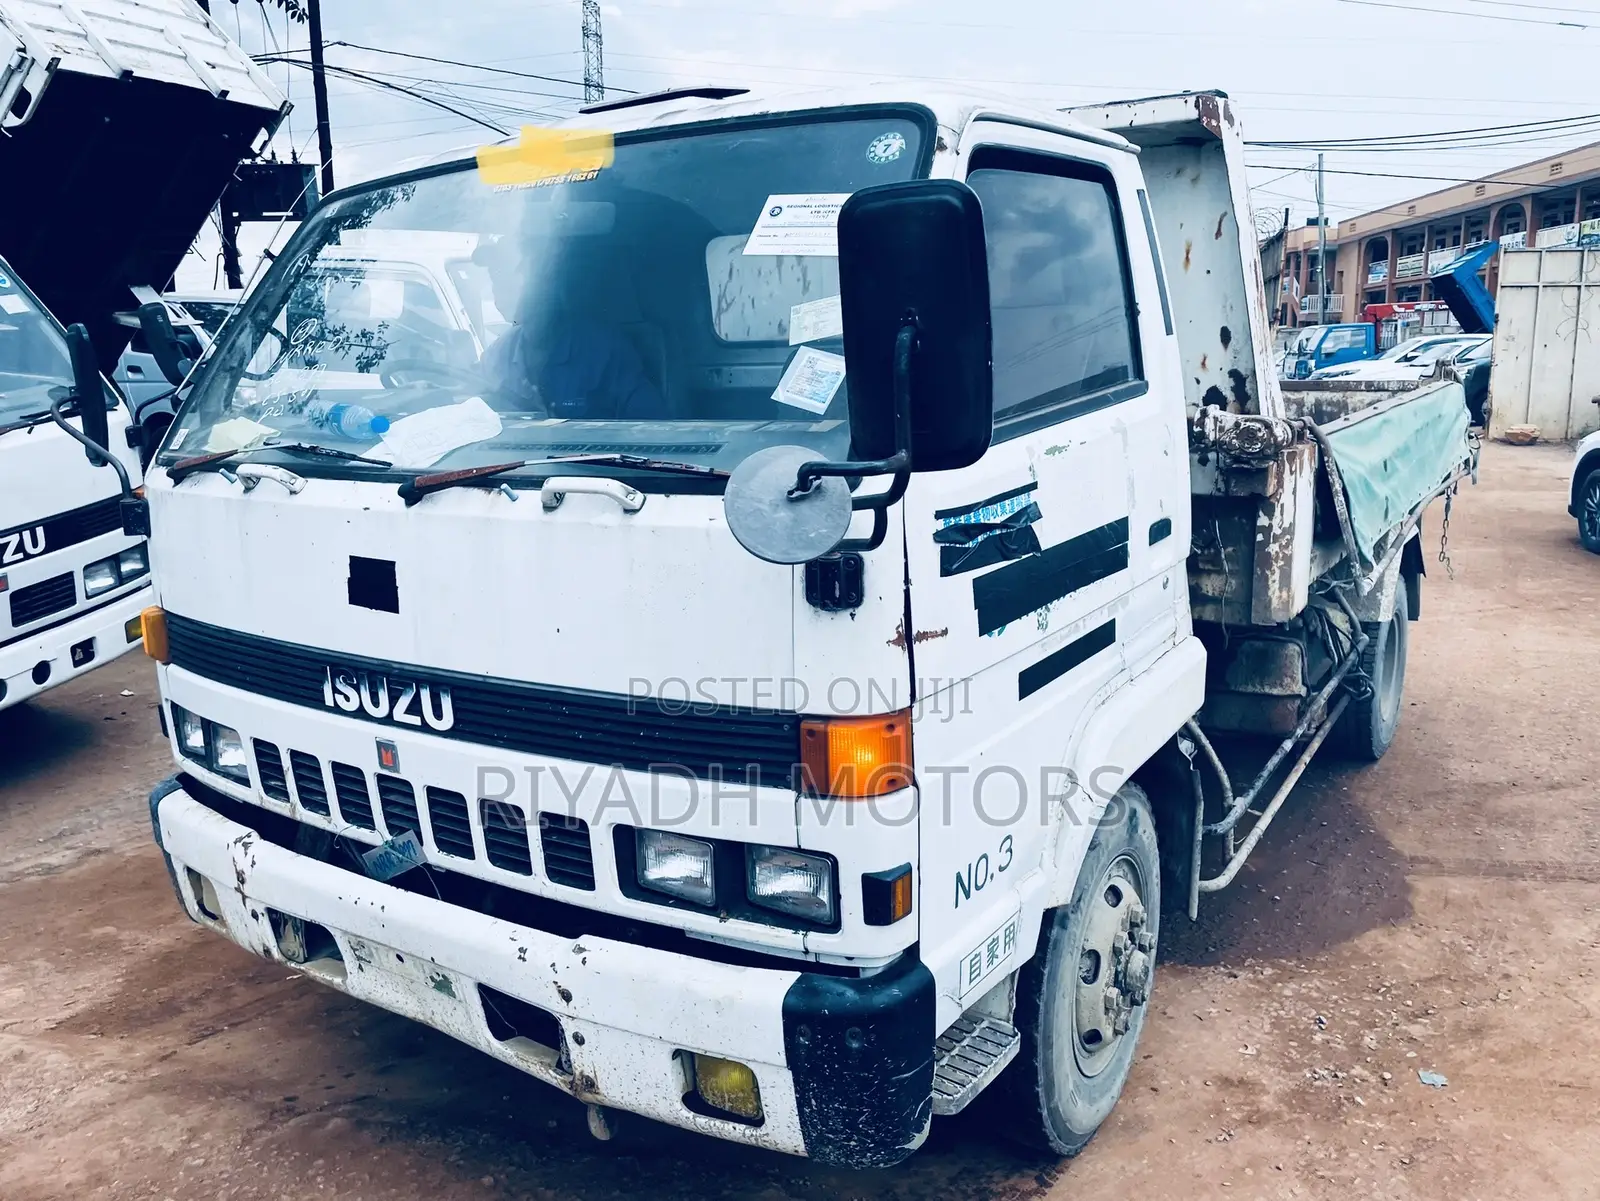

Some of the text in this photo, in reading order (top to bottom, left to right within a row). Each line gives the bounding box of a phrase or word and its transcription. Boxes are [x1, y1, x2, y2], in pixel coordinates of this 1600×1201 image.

[322, 665, 454, 731] ISUZU
[968, 921, 1016, 985] 自家用
